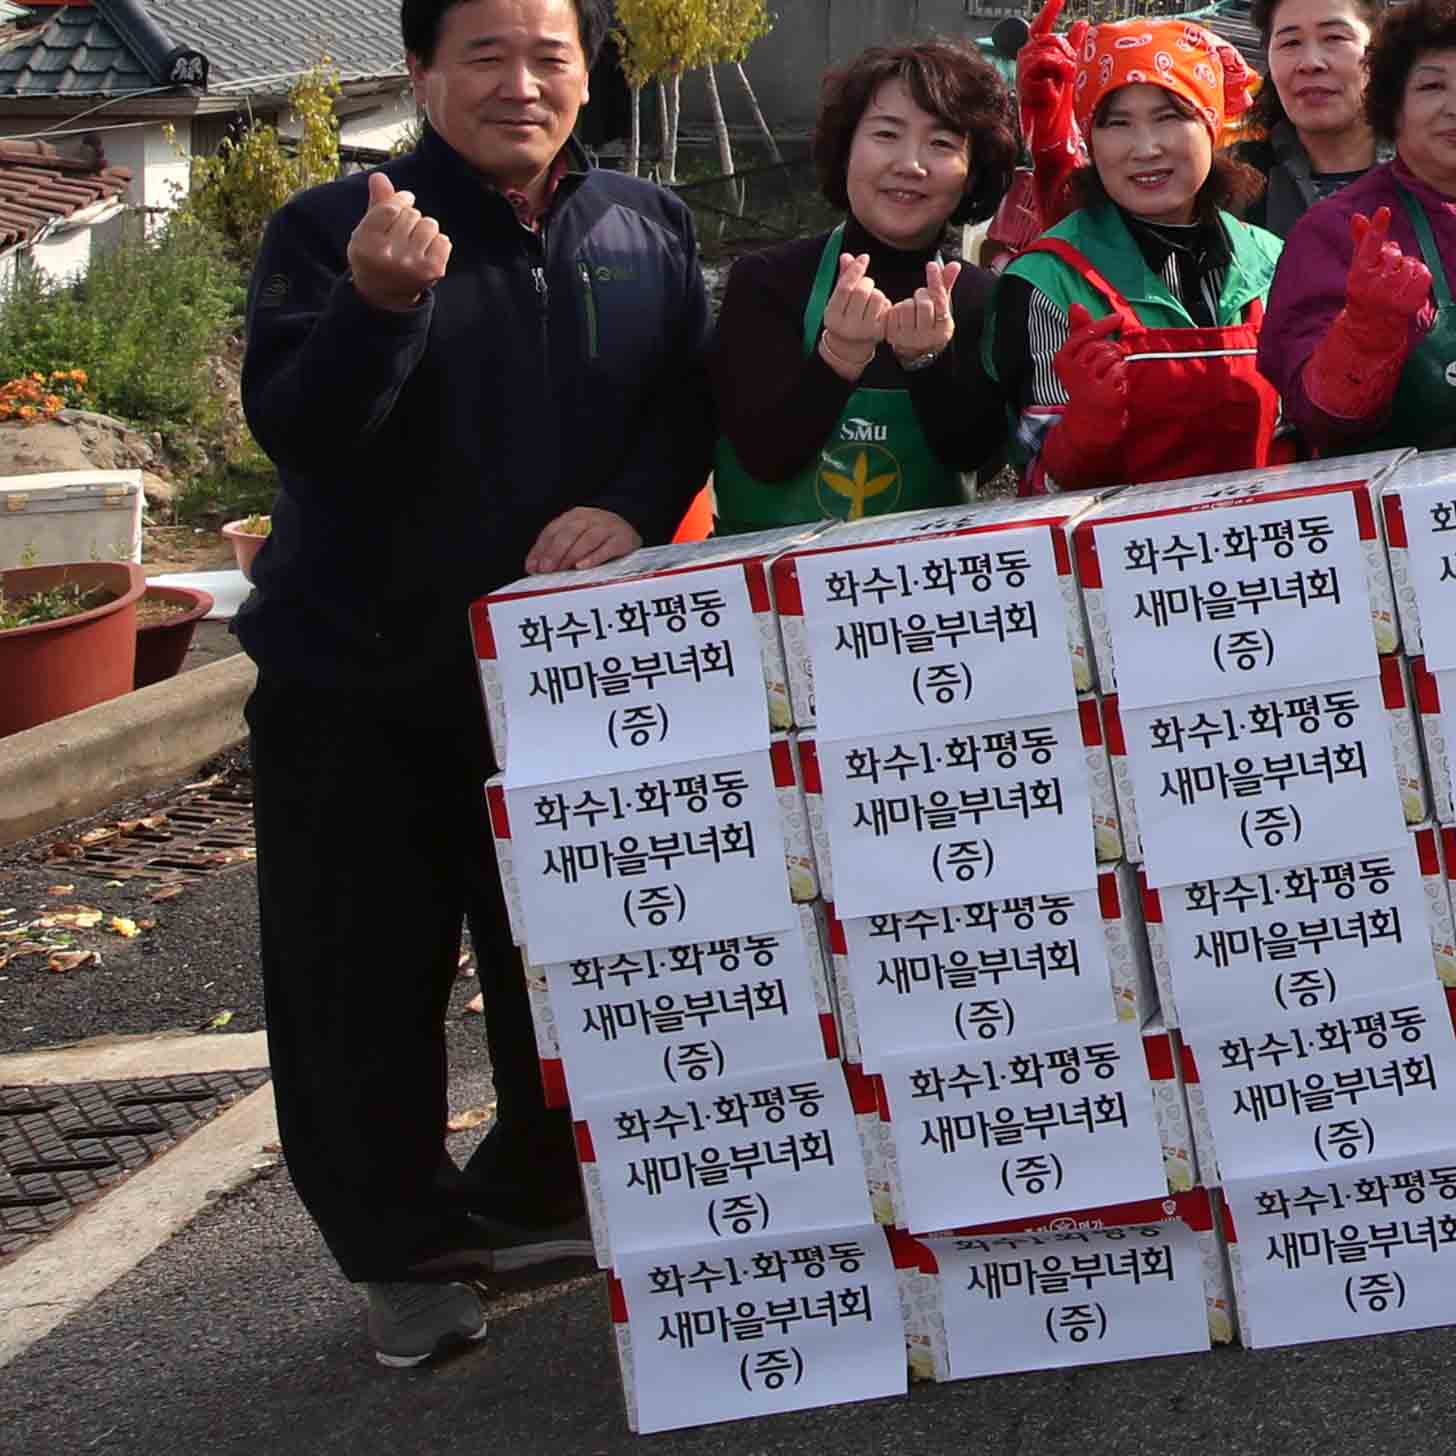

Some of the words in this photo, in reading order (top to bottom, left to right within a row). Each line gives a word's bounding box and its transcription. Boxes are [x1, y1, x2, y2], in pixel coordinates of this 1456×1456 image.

[1133, 566, 1341, 628] 새마을부녀회
[834, 600, 1039, 660] 새마을부녀회
[1213, 628, 1274, 673] (증)
[528, 639, 735, 705] 새마을부녀회
[608, 703, 668, 749] (증)
[1159, 740, 1368, 806] 새마을부녀회
[852, 776, 1064, 837] 새마을부녀회
[1240, 804, 1302, 849] (증)
[541, 820, 756, 884] 새마을부녀회
[623, 883, 686, 928] (증)
[876, 938, 1081, 995] 새마을부녀회
[1193, 906, 1403, 969] 새마을부녀회
[581, 978, 789, 1042] 새마을부녀회
[1274, 967, 1336, 1010] (증)
[663, 1039, 725, 1083] (증)
[1232, 1053, 1438, 1123] 새마을부녀회
[920, 1090, 1129, 1155] 새마을부녀회
[1314, 1117, 1375, 1161] (증)
[626, 1128, 835, 1196] 새마을부녀회
[708, 1192, 769, 1237] (증)
[965, 1244, 1175, 1300] 새마을부녀회
[1344, 1271, 1406, 1313] (증)
[657, 1283, 873, 1350] 새마을부녀회
[740, 1346, 804, 1392] (증)
